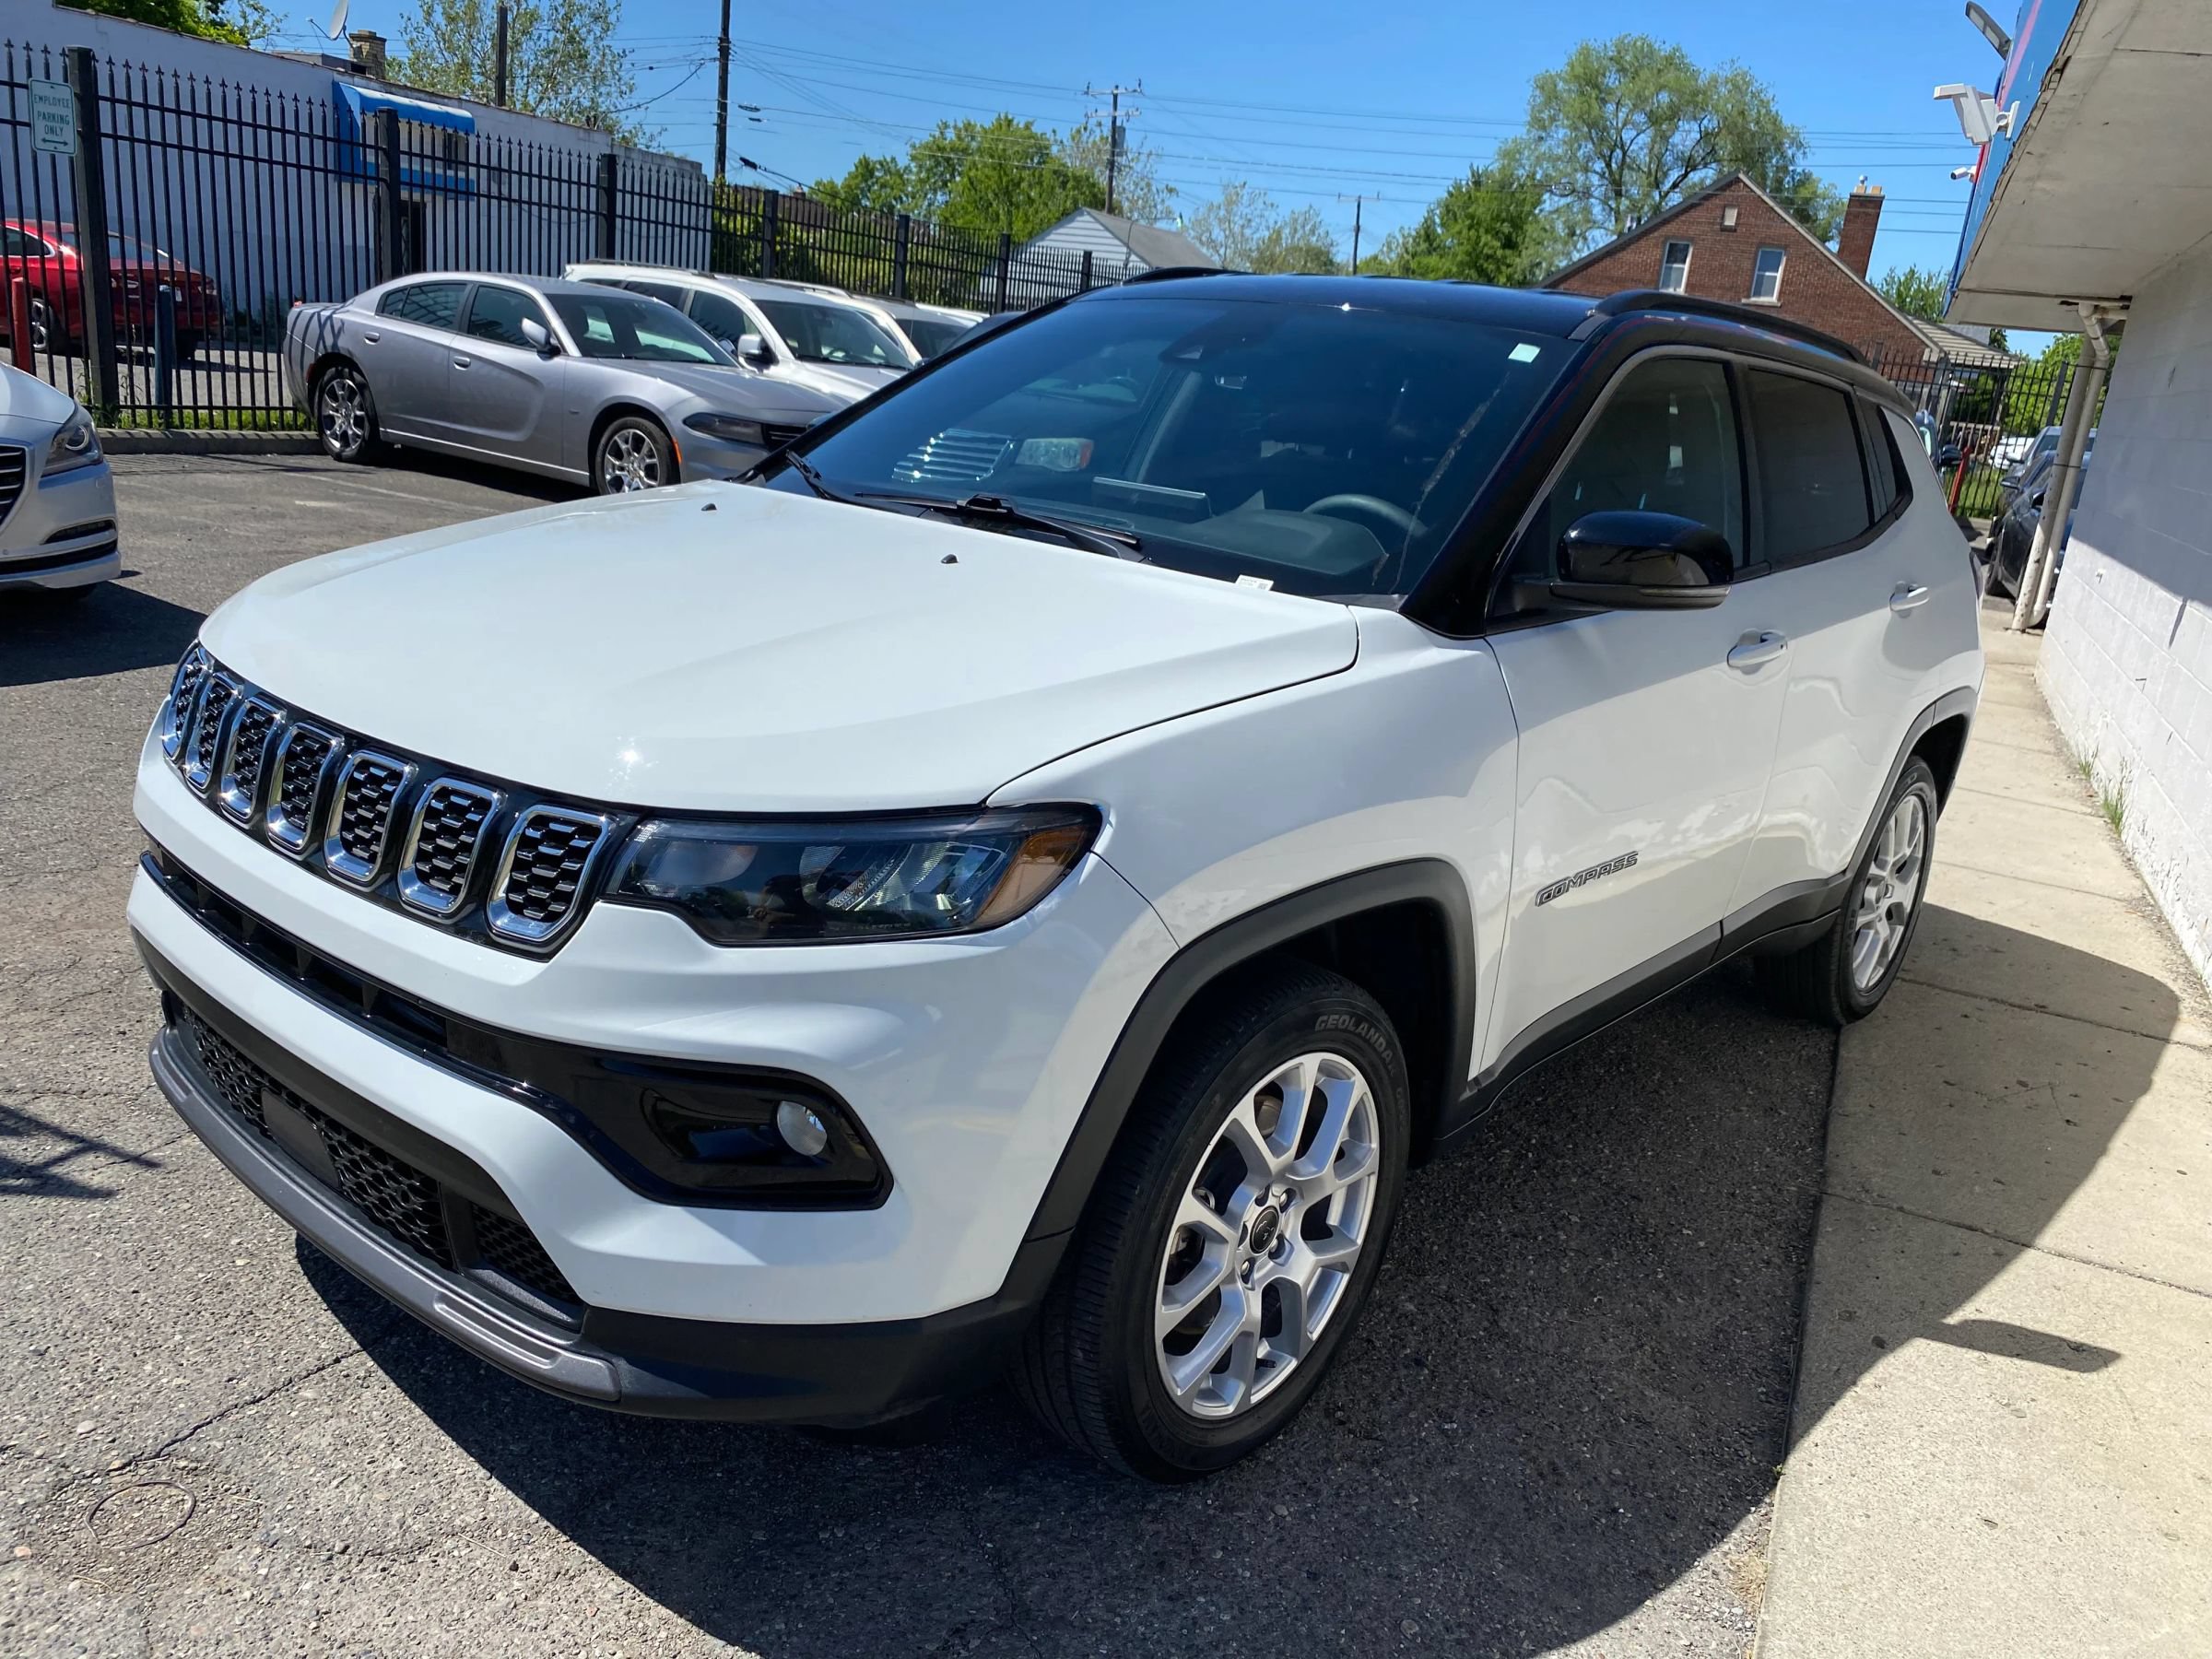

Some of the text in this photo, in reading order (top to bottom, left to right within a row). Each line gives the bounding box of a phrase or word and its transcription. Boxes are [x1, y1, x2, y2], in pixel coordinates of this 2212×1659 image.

[34, 94, 71, 109] EMPLOYEE
[37, 111, 70, 125] PARKING
[44, 124, 64, 136] ONLY
[1535, 851, 1639, 907] COMPASS
